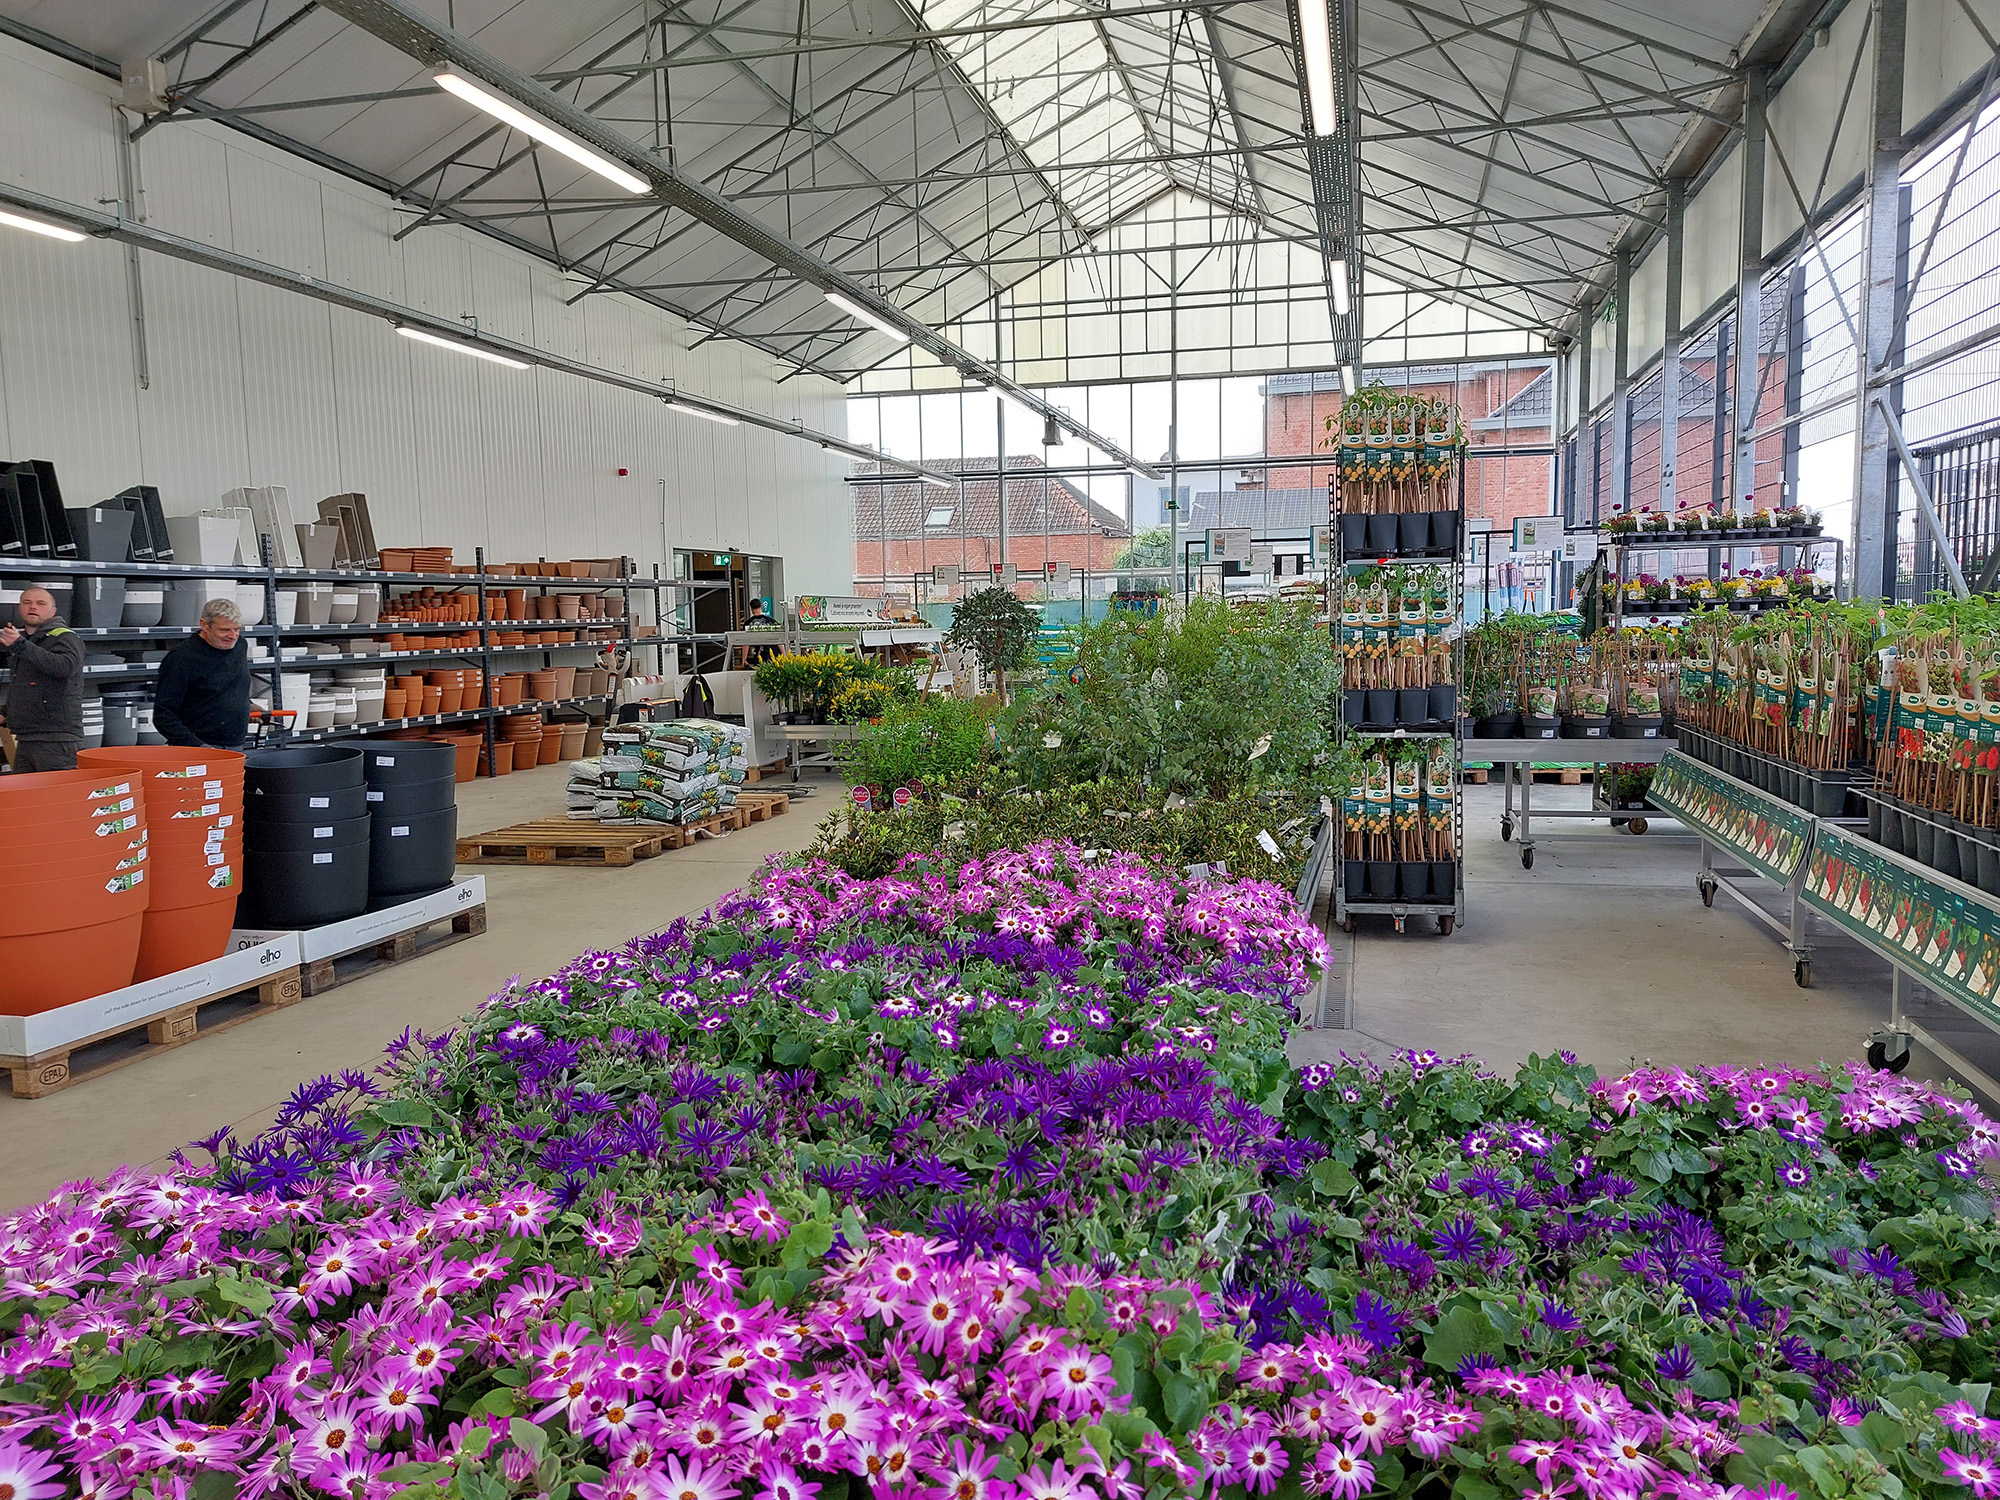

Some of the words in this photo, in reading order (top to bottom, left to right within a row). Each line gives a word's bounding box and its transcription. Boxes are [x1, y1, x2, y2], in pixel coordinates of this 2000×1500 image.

[458, 888, 472, 901] elho
[260, 949, 281, 964] elho
[284, 984, 297, 995] EPAL
[44, 1067, 64, 1082] EPAL
